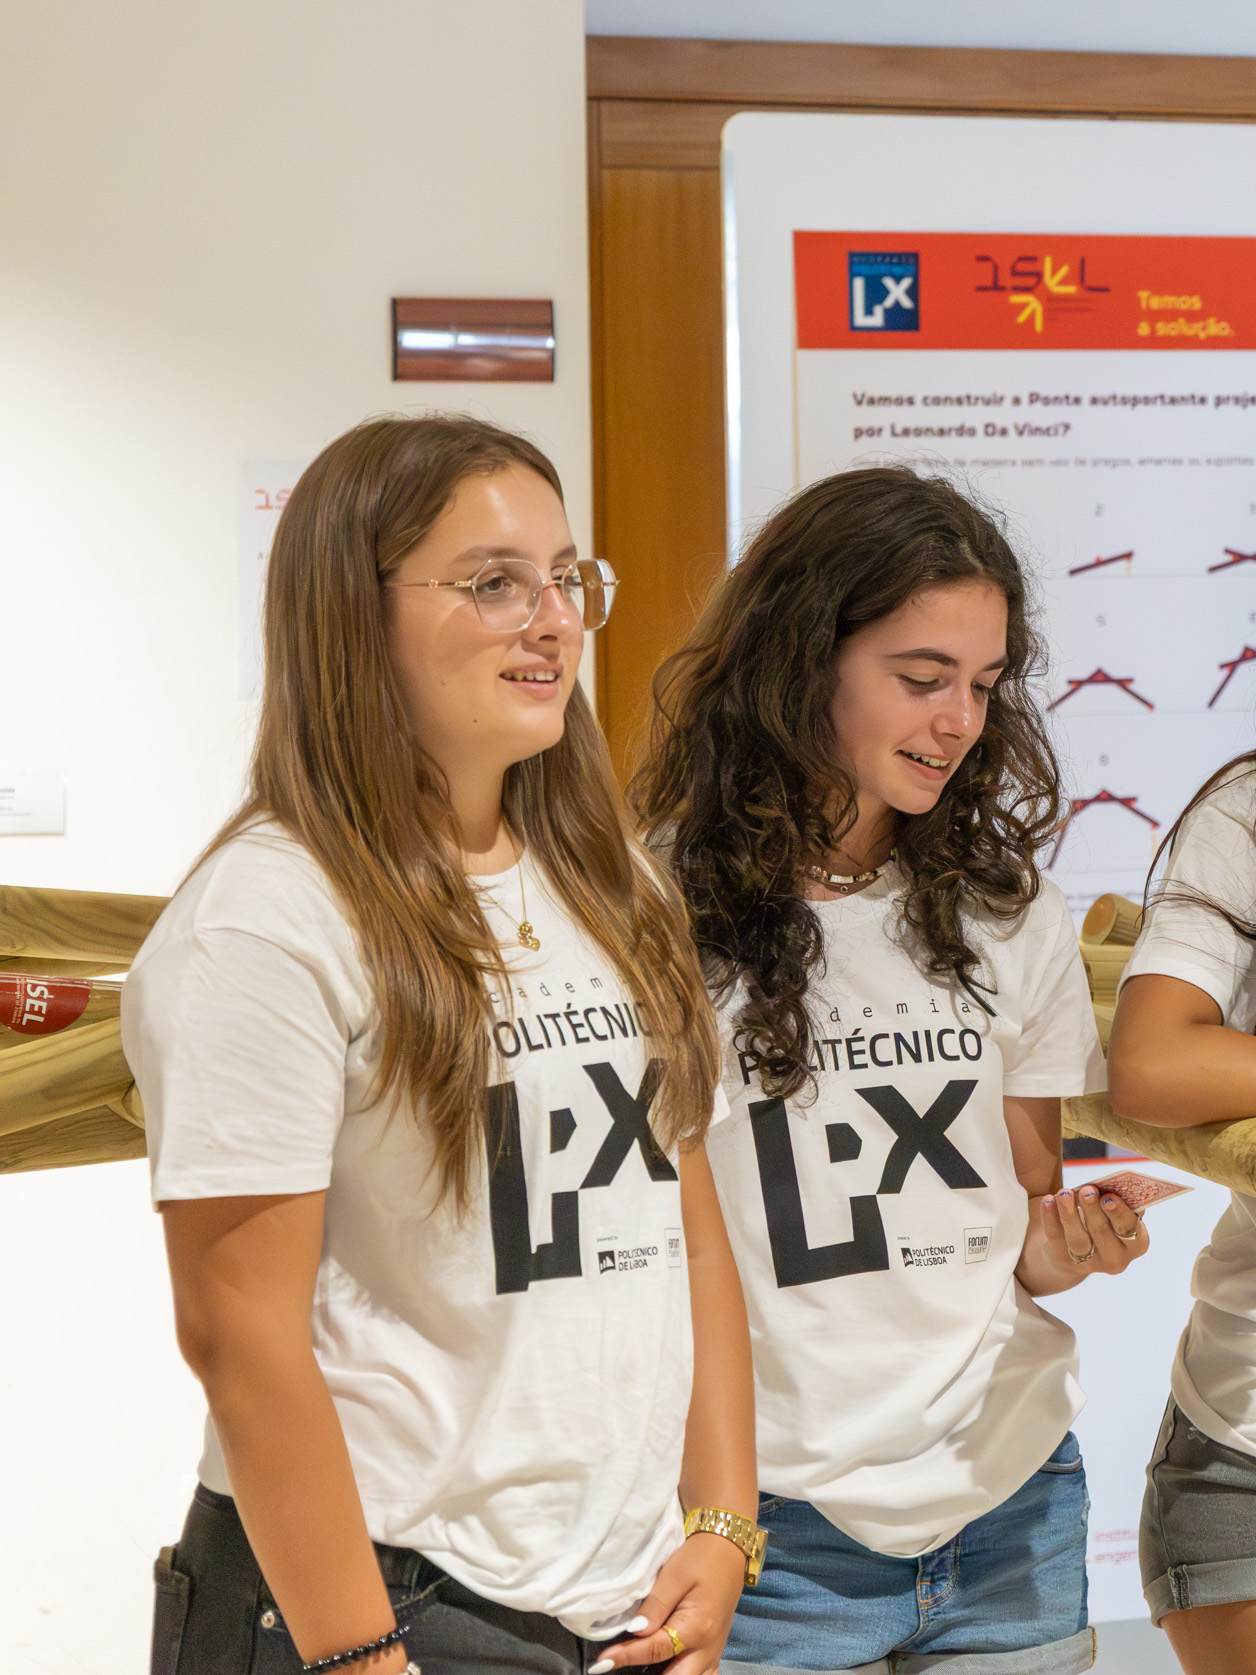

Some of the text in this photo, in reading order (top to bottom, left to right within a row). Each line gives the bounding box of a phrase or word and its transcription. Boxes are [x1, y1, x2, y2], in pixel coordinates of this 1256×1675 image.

[1137, 290, 1202, 310] Temos
[1138, 321, 1151, 336] a
[852, 392, 915, 407] Vamos
[922, 392, 1004, 407] construir
[1012, 396, 1021, 407] a
[1029, 391, 1080, 407] Ponte
[1089, 393, 1207, 410] autoportante
[853, 422, 1071, 442] por Leonardo Da Vinci?
[912, 1245, 955, 1257] POLITÉCNICO
